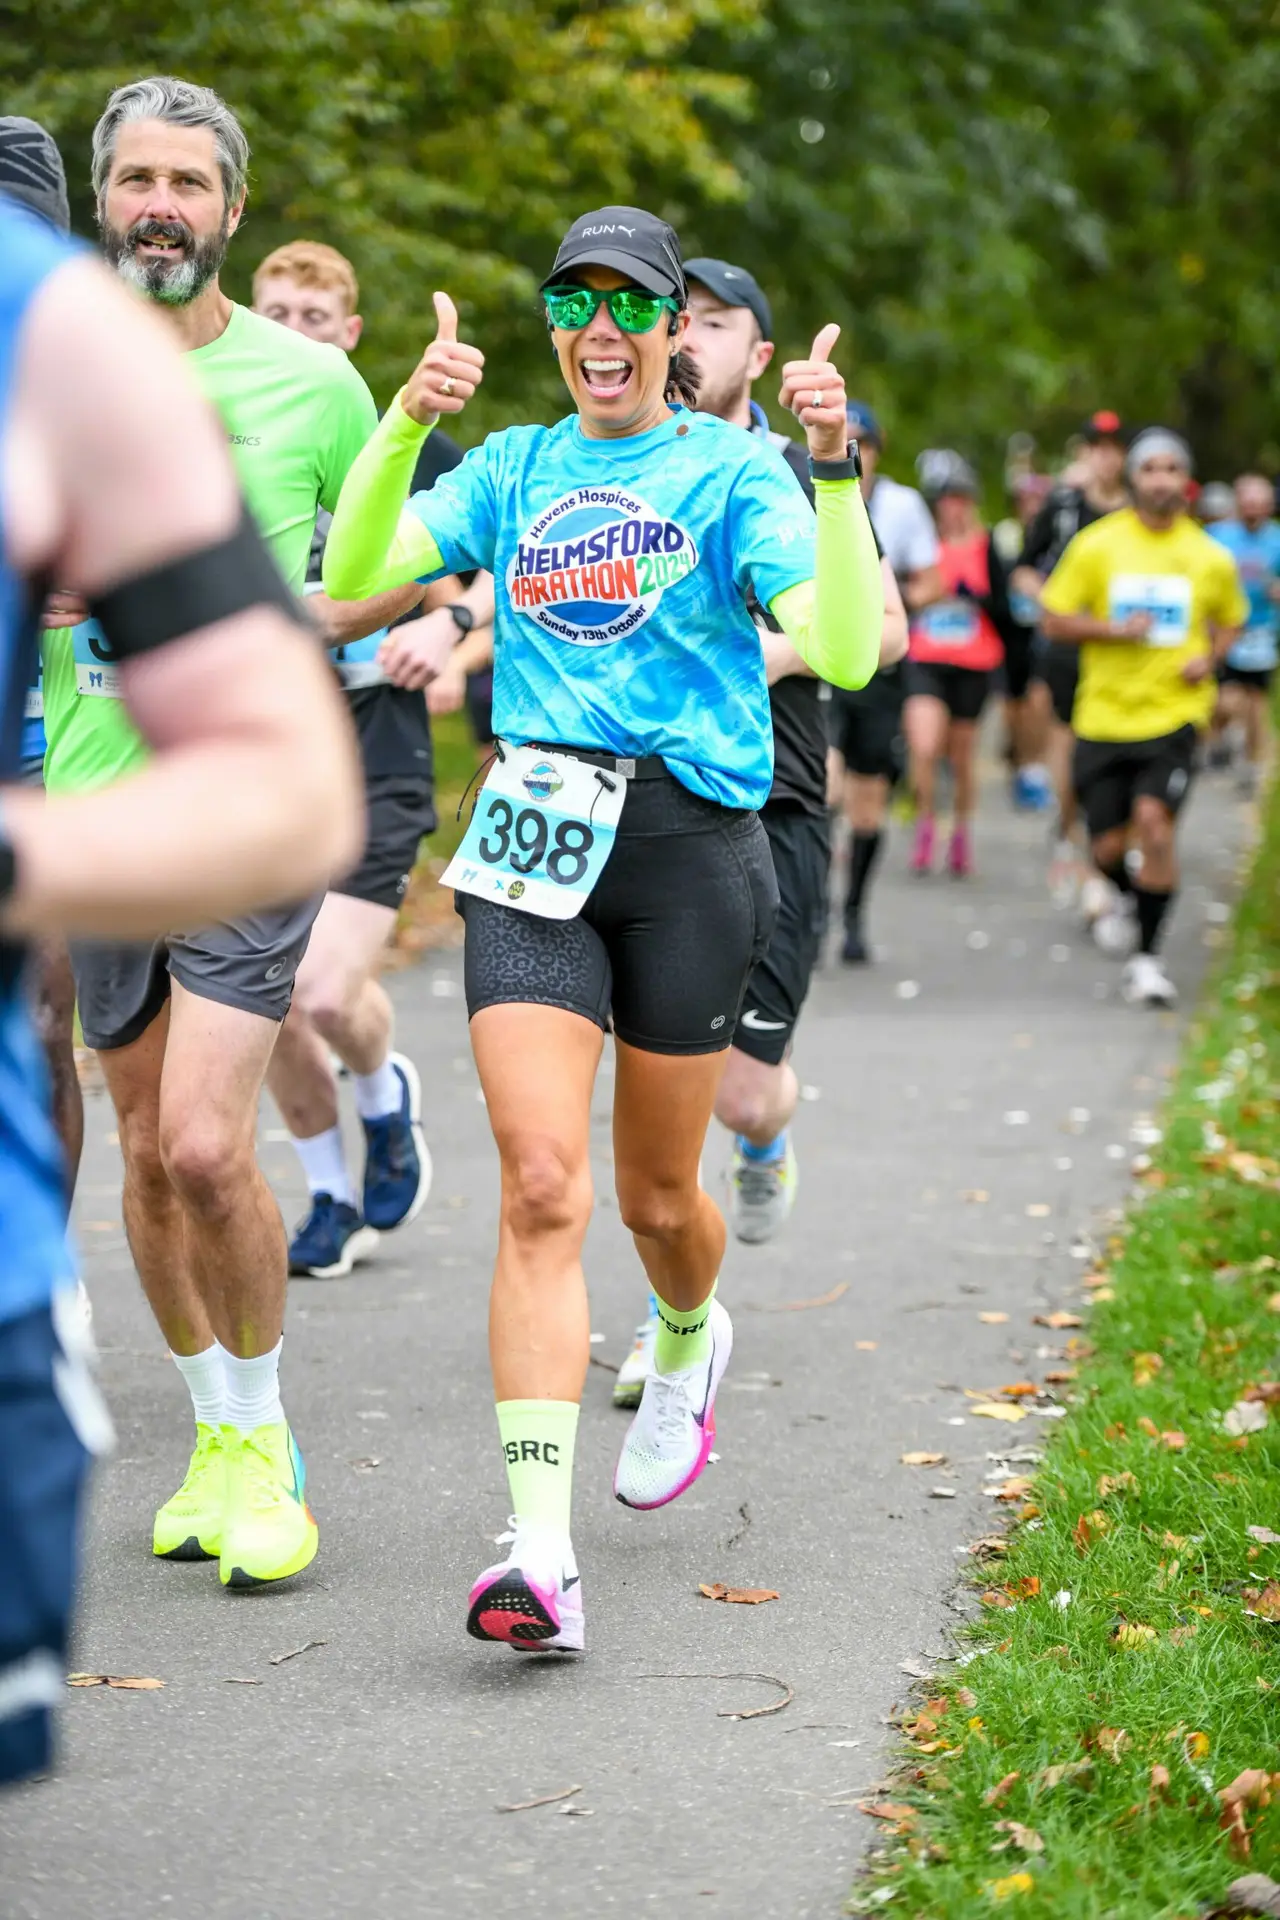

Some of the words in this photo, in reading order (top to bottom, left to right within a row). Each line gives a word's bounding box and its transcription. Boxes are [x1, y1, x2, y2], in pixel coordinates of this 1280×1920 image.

[582, 224, 615, 238] RUN
[530, 497, 576, 538] Havens
[578, 489, 642, 514] Hospices
[515, 519, 684, 577] HELMSFORD
[636, 552, 691, 597] 2024
[536, 611, 579, 641] Sunday
[583, 628, 608, 641] 13th
[608, 604, 647, 635] October
[479, 799, 594, 885] 398
[503, 1440, 560, 1466] SRC
